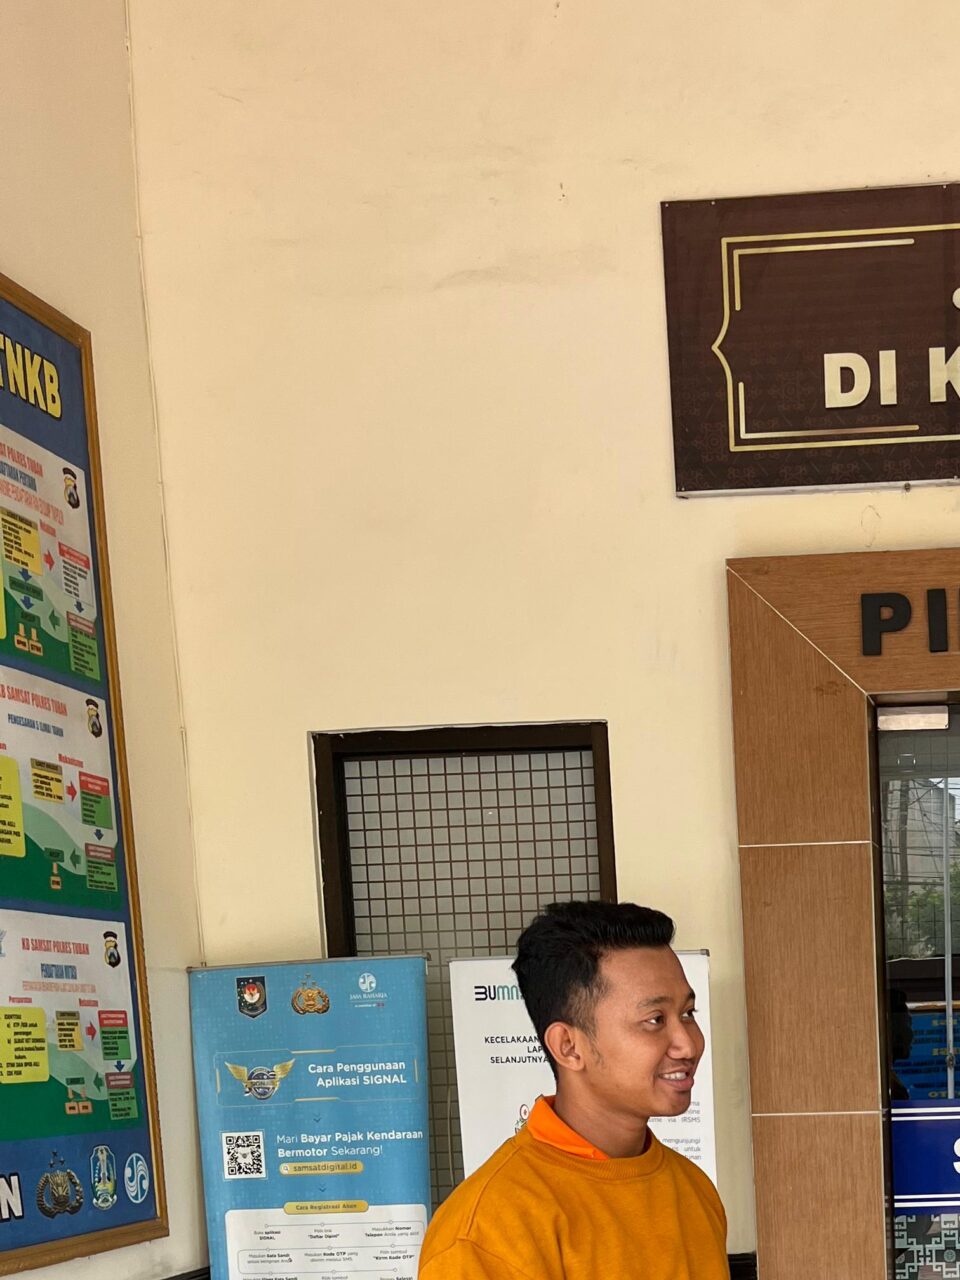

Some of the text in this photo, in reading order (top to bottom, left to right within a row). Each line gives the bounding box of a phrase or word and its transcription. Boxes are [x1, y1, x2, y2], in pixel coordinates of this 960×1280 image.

[823, 352, 897, 408] DI
[484, 1035, 539, 1044] KECELAKAAN
[490, 1055, 550, 1064] SELANJUTNYA
[308, 1061, 406, 1074] Cara Penggunaan
[316, 1074, 407, 1089] Aplikasi SIGNAL
[276, 1130, 423, 1146] Mari Bayar Pajak Kendaraan
[277, 1145, 383, 1158] Bermotor Sekarang!
[293, 1161, 358, 1173] samsatdigital.id
